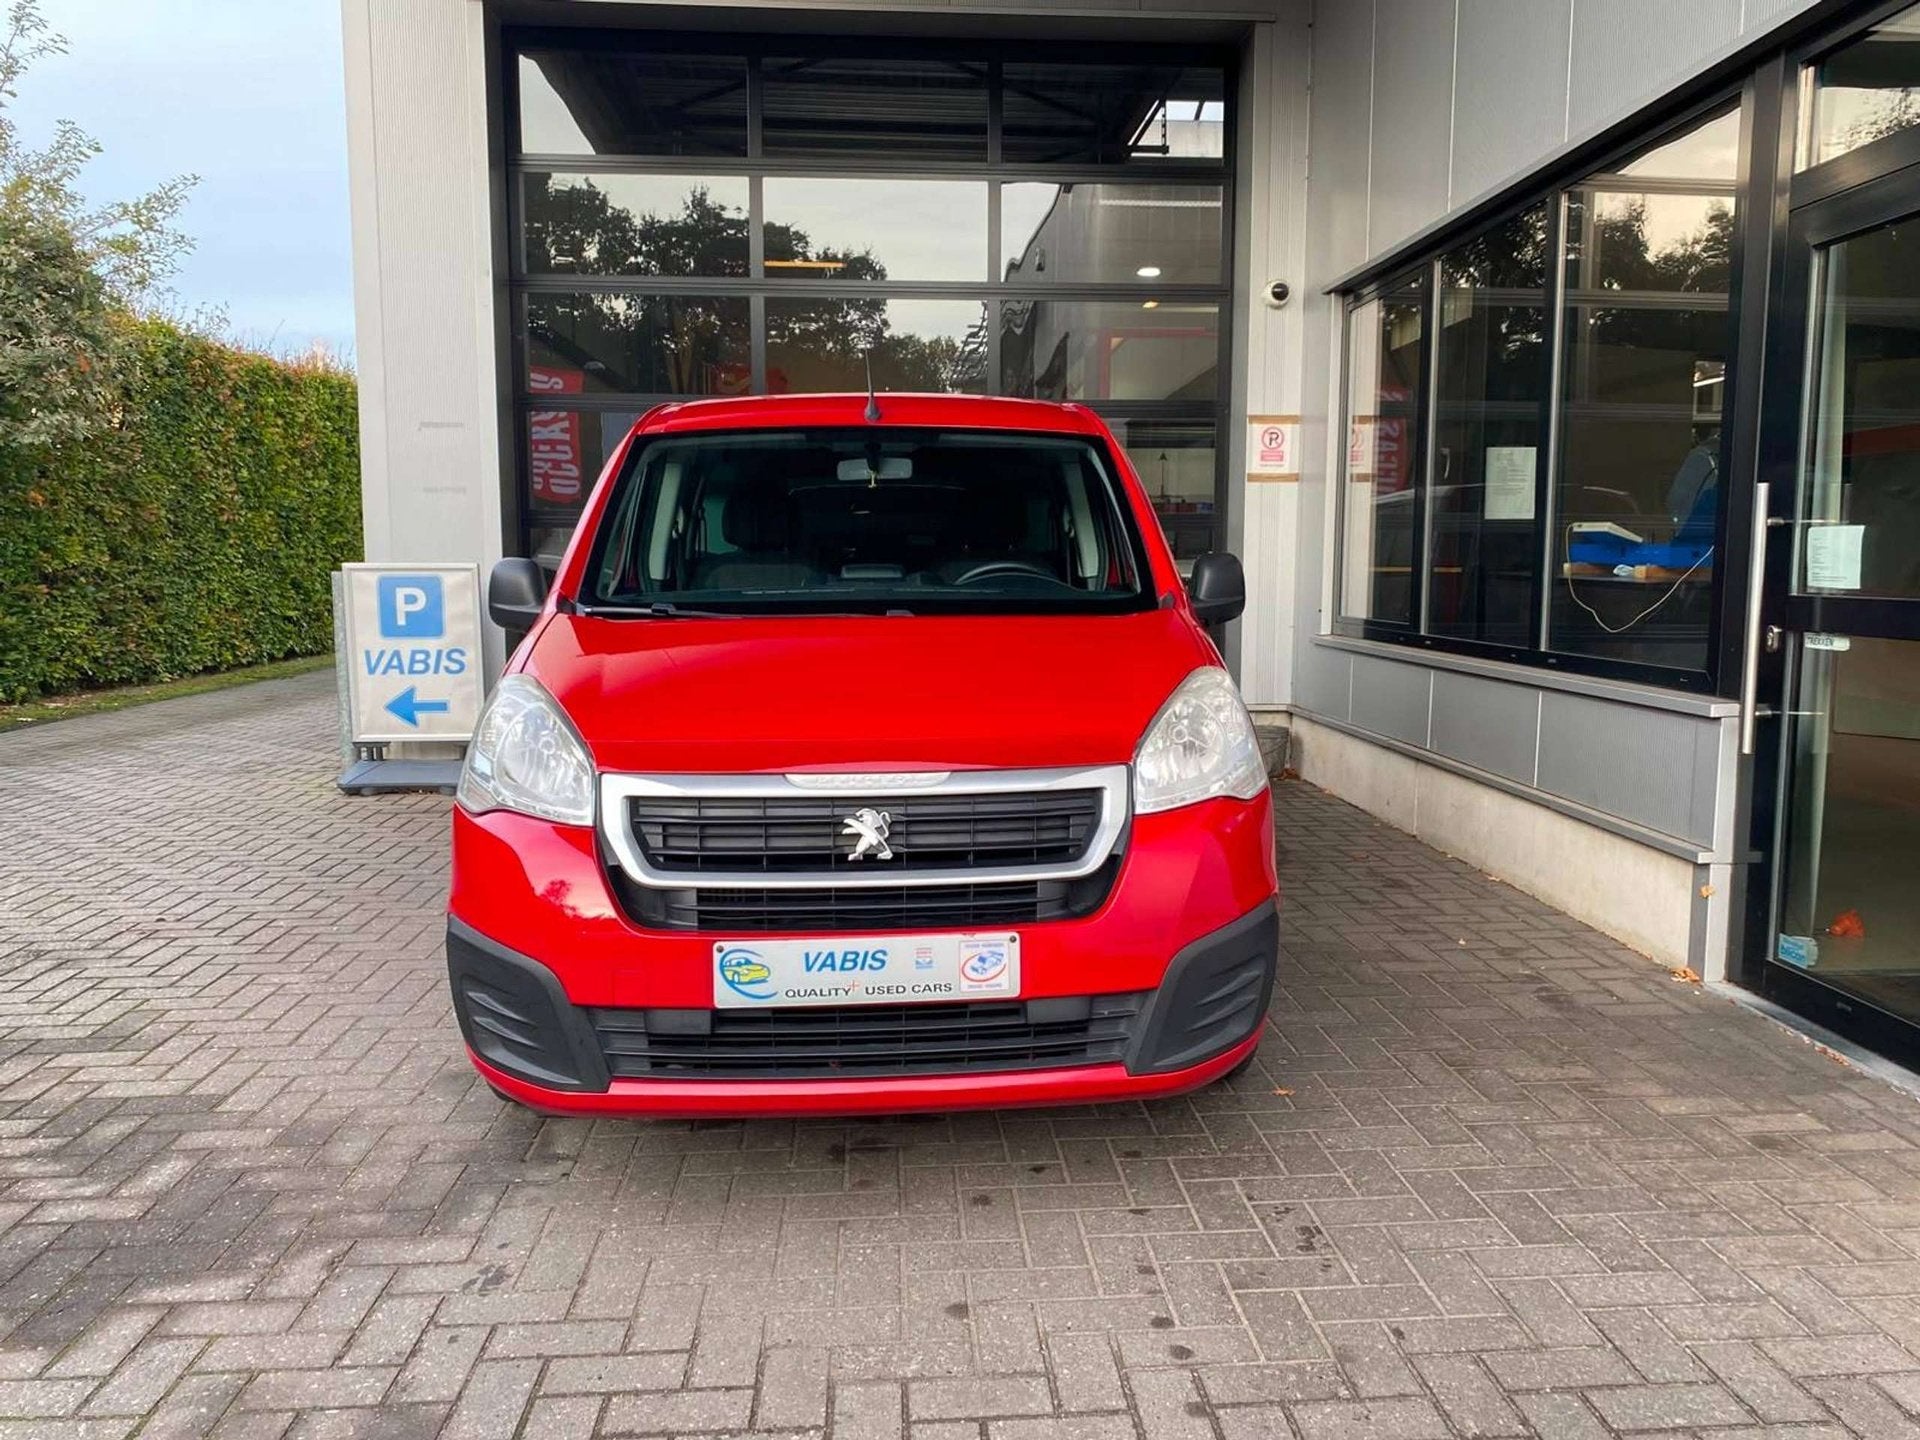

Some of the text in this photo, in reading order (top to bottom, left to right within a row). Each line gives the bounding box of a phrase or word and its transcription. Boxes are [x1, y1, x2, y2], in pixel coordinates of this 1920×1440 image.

[395, 587, 427, 626] P
[364, 649, 467, 675] VABIS
[803, 949, 888, 974] VABIS
[785, 982, 952, 999] QUALITY USED CARS
